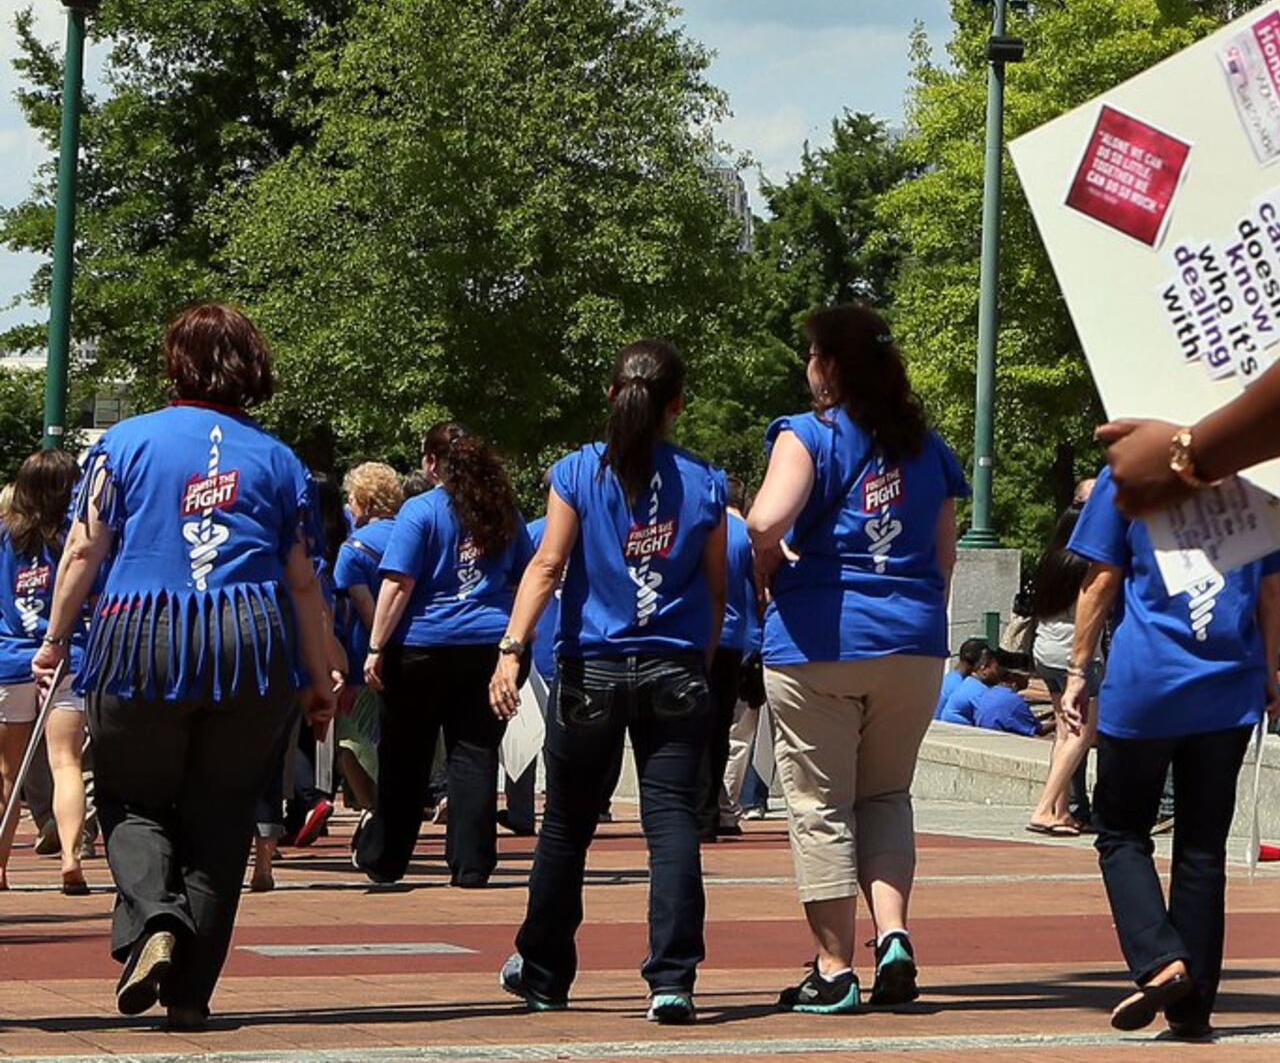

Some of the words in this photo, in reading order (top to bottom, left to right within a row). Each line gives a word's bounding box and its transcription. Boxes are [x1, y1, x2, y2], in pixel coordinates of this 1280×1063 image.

[1162, 285, 1202, 359] with
[1174, 245, 1232, 368] dealing
[1199, 243, 1235, 315] who
[1228, 322, 1259, 375] it's
[1225, 242, 1274, 333] know
[184, 483, 236, 513] FIGHT
[865, 479, 901, 511] FIGHT
[625, 531, 673, 556] FIGHT
